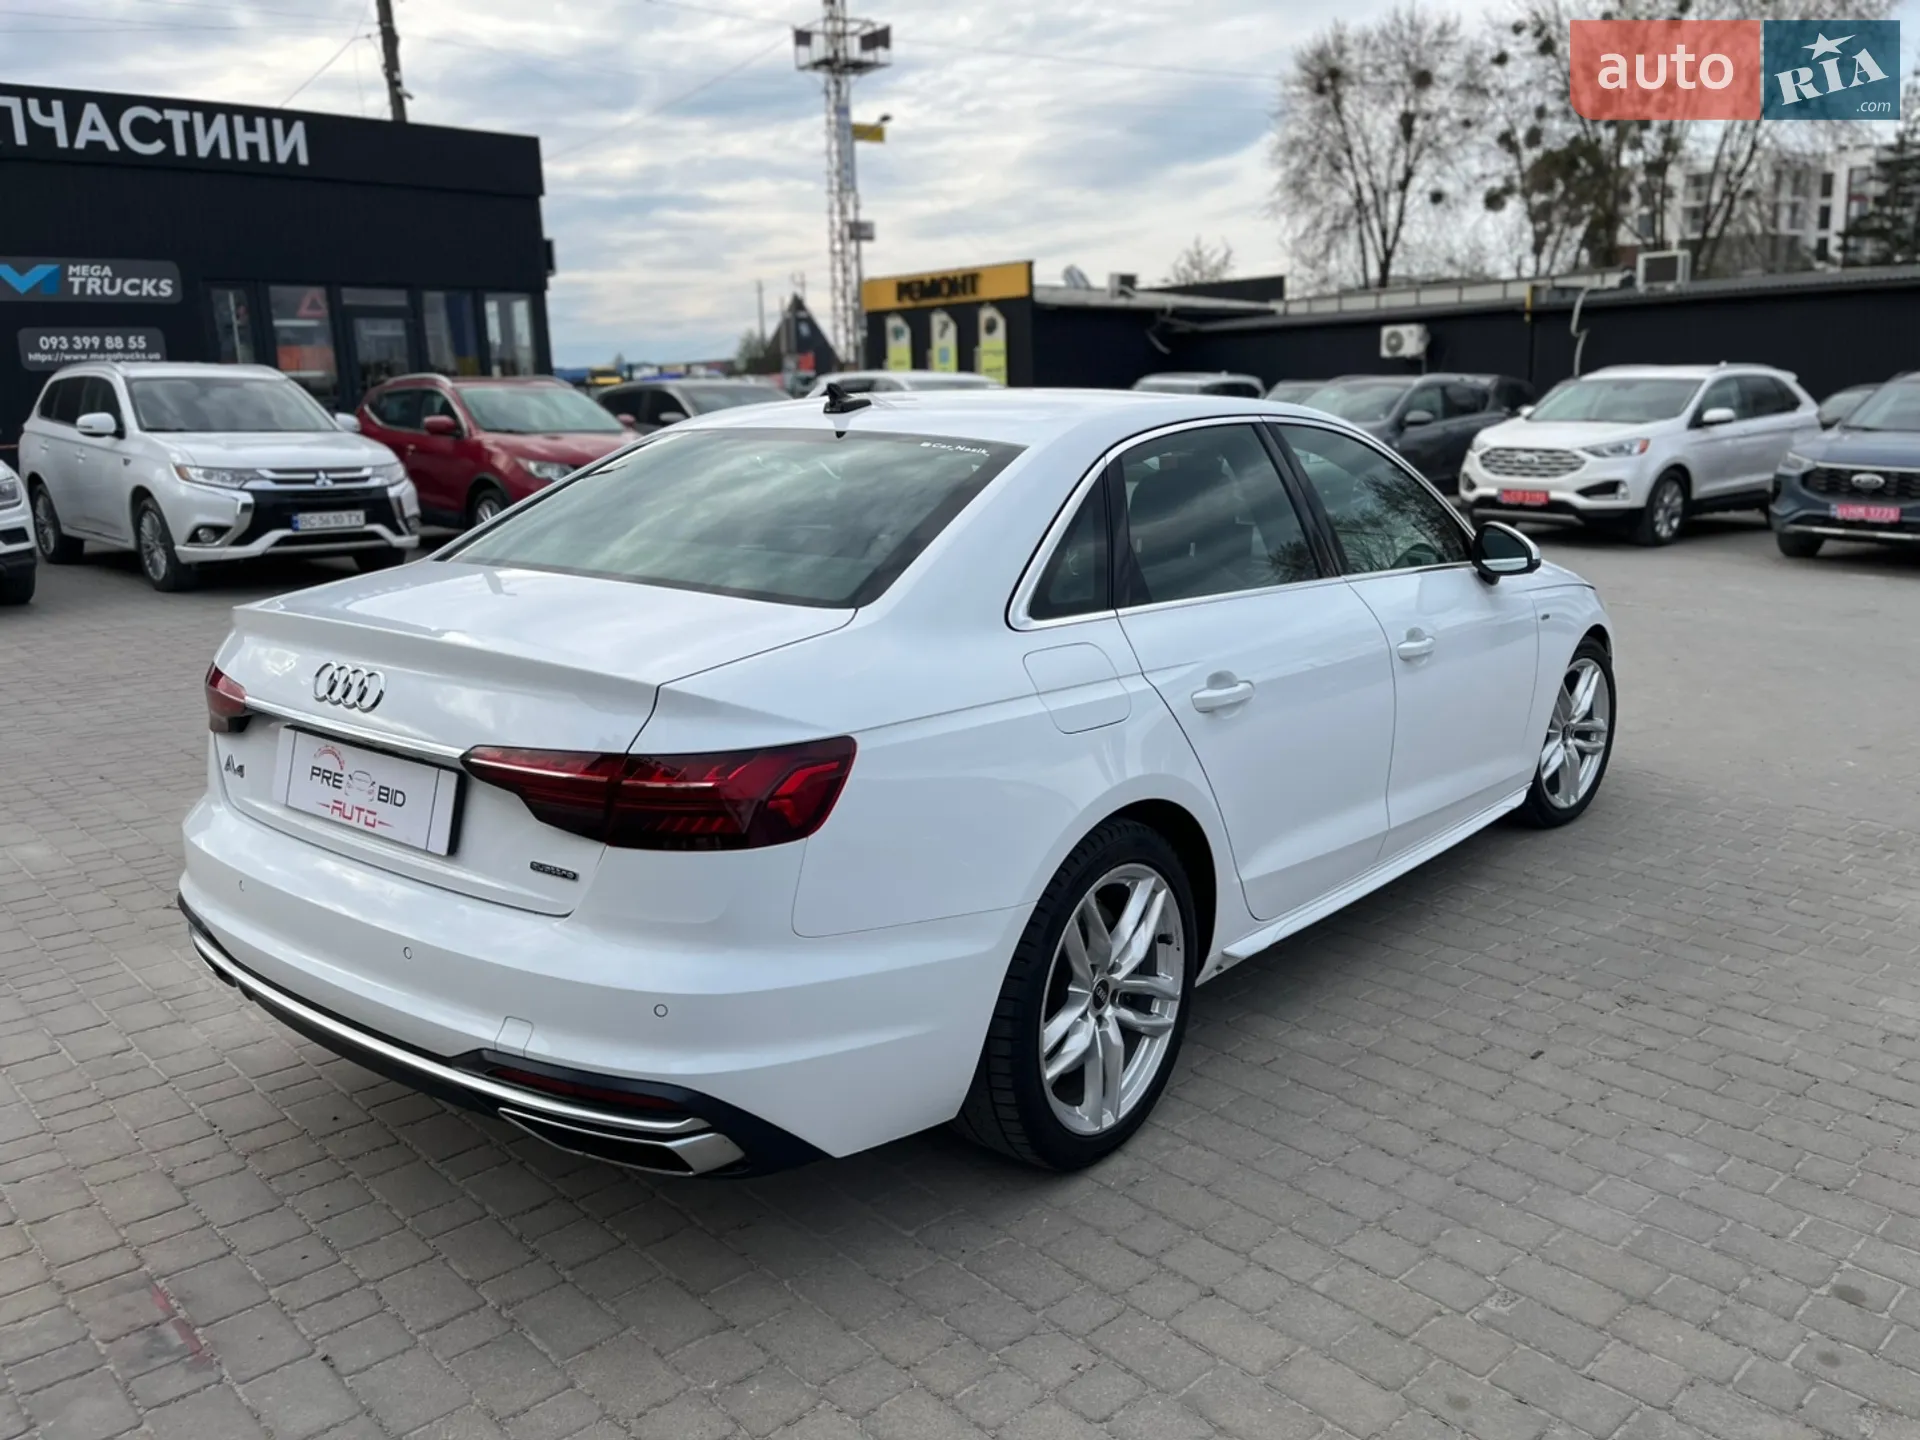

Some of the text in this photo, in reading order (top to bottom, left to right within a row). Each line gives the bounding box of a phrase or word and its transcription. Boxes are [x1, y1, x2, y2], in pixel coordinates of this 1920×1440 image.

[68, 265, 113, 277] MEGA
[68, 277, 173, 297] TRUCKS
[39, 336, 147, 350] 093 399 88 55
[224, 754, 245, 779] A4
[309, 765, 406, 808] PRE BID
[330, 800, 377, 829] AUTO
